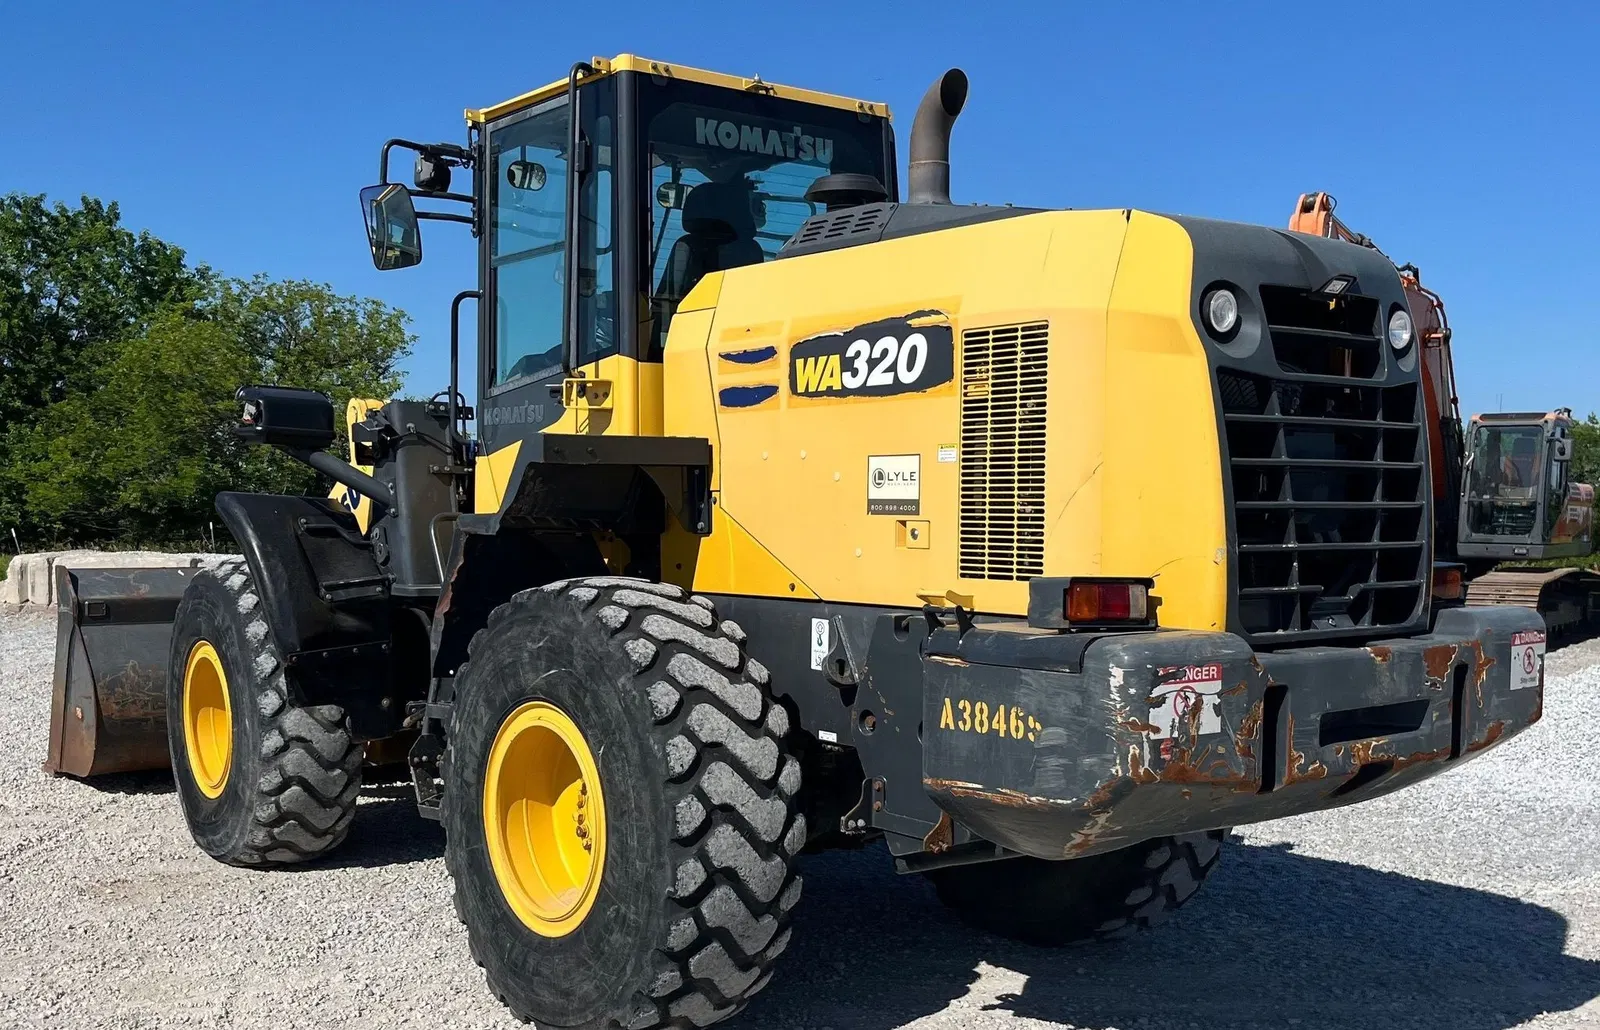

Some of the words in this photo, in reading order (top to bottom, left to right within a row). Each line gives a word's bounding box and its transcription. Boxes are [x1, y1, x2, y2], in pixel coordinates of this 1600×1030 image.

[695, 117, 833, 164] KOMATSU
[795, 333, 928, 393] WA320
[484, 400, 544, 426] KOMATSU
[887, 471, 917, 481] LYLE
[1169, 666, 1218, 682] NGER
